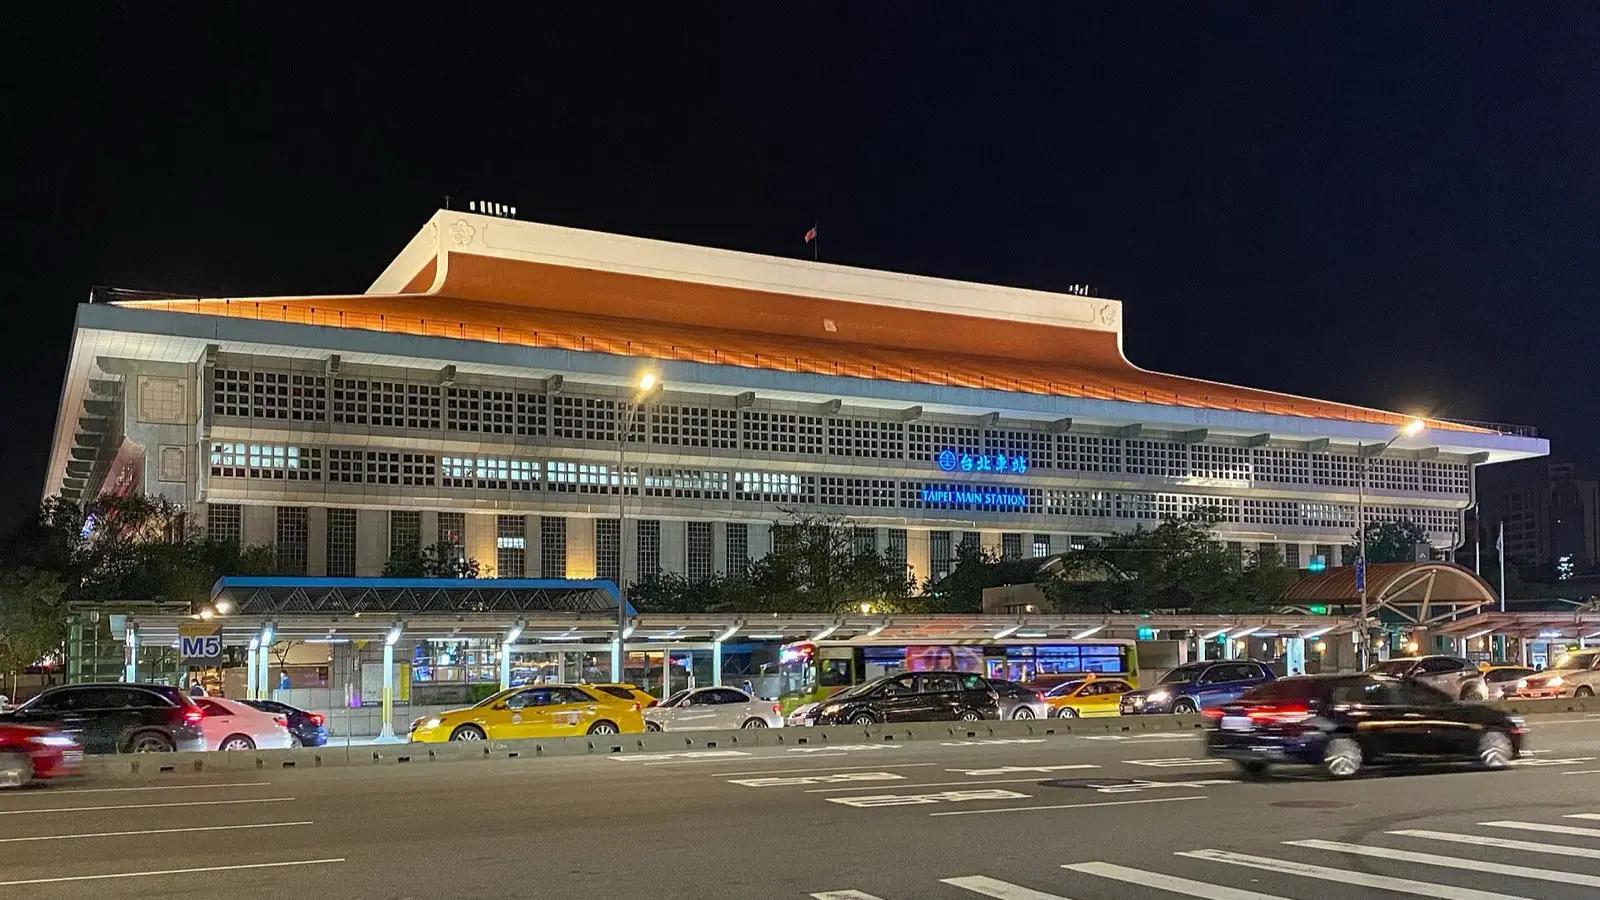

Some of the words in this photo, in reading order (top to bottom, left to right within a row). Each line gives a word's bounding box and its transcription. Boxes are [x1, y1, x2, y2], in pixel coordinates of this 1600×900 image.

[960, 453, 1027, 474] 台北車站
[923, 490, 952, 502] TAIPEI
[955, 491, 982, 504] MAIN
[985, 493, 1026, 506] STATION
[182, 635, 221, 658] M5
